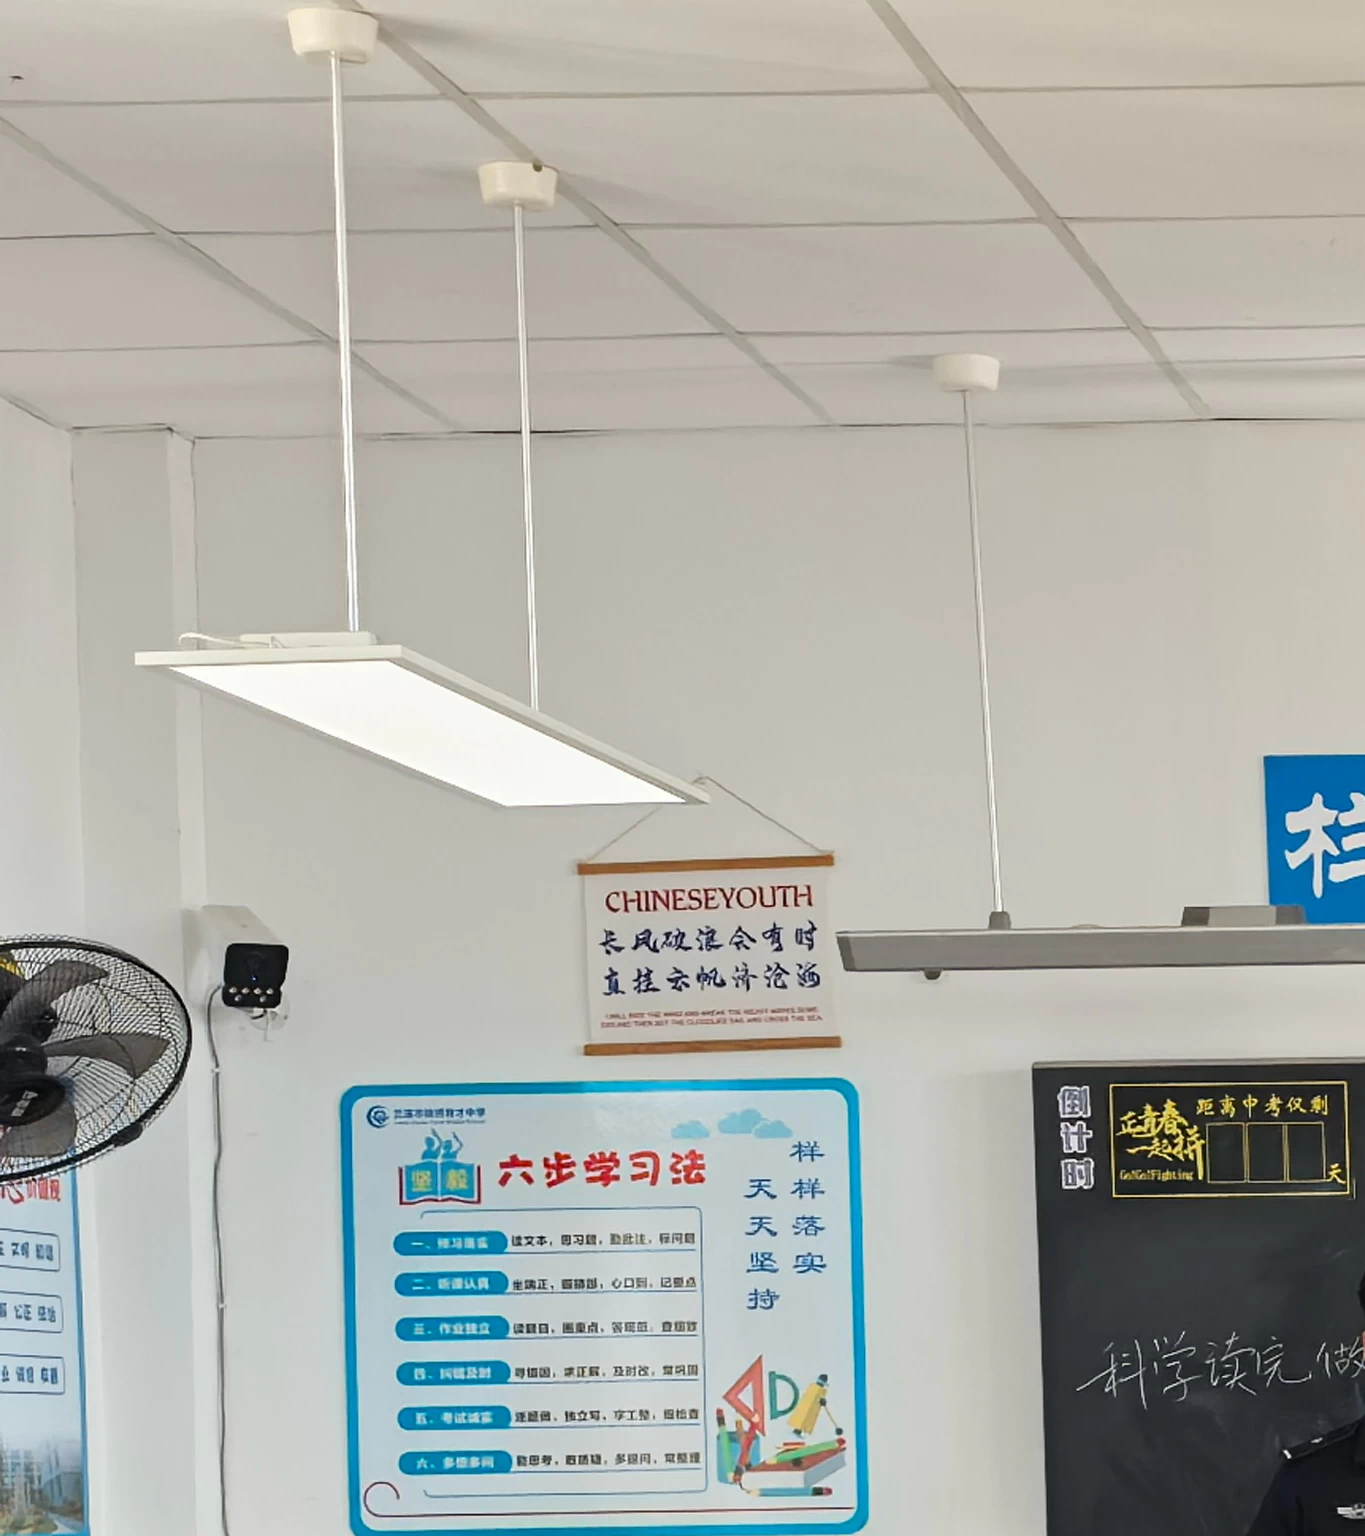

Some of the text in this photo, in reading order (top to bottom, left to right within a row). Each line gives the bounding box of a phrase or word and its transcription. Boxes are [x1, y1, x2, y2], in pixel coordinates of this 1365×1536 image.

[605, 885, 814, 913] CHINESEYOUTH
[599, 919, 818, 955] 长风破浪会有时
[602, 962, 821, 996] 直挂云帆济沧海
[1196, 1094, 1329, 1118] 距离中考仅剩
[1058, 1085, 1096, 1190] 倒计时
[498, 1150, 706, 1188] 六步学习法
[1327, 1162, 1347, 1185] 天
[789, 1141, 828, 1275] 样样落实
[744, 1178, 781, 1312] 天天坚持
